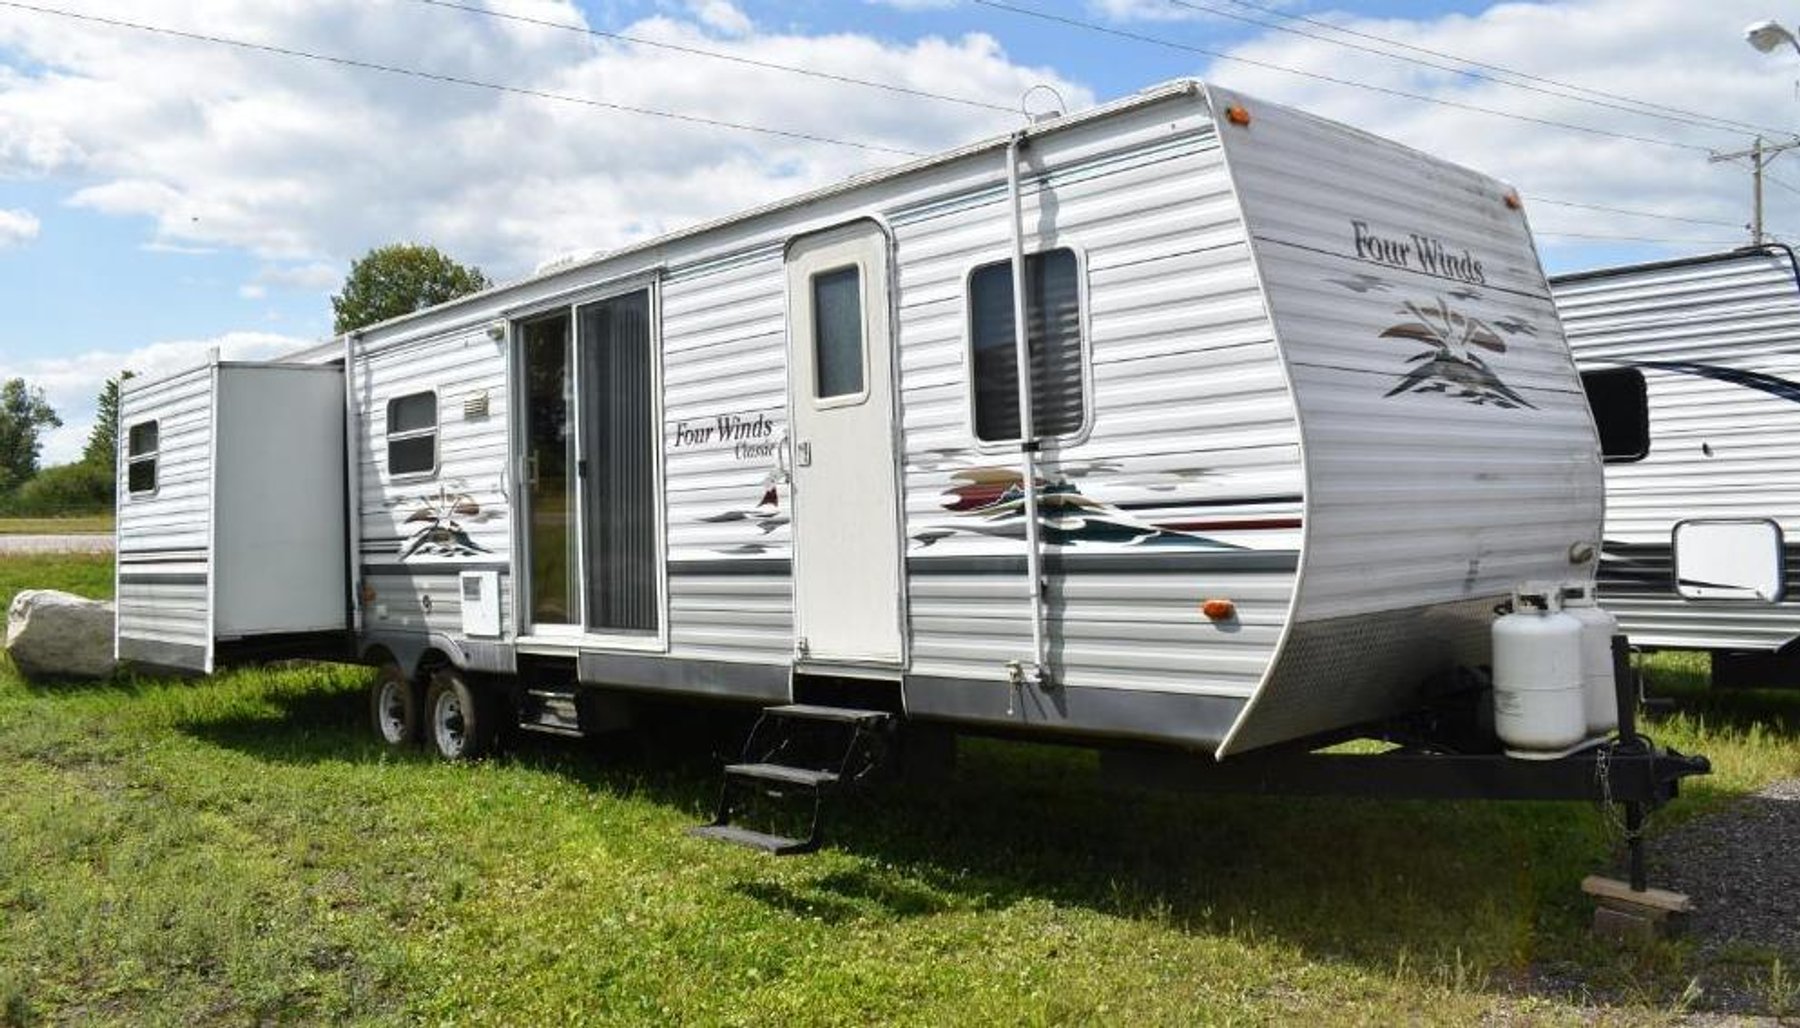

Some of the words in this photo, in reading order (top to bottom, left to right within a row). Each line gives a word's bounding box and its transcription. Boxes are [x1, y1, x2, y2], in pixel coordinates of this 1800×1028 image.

[1351, 220, 1411, 266] Four
[1410, 234, 1485, 284] Winds
[674, 422, 714, 447] Four
[716, 414, 774, 441] Winds
[734, 440, 775, 460] Classic
